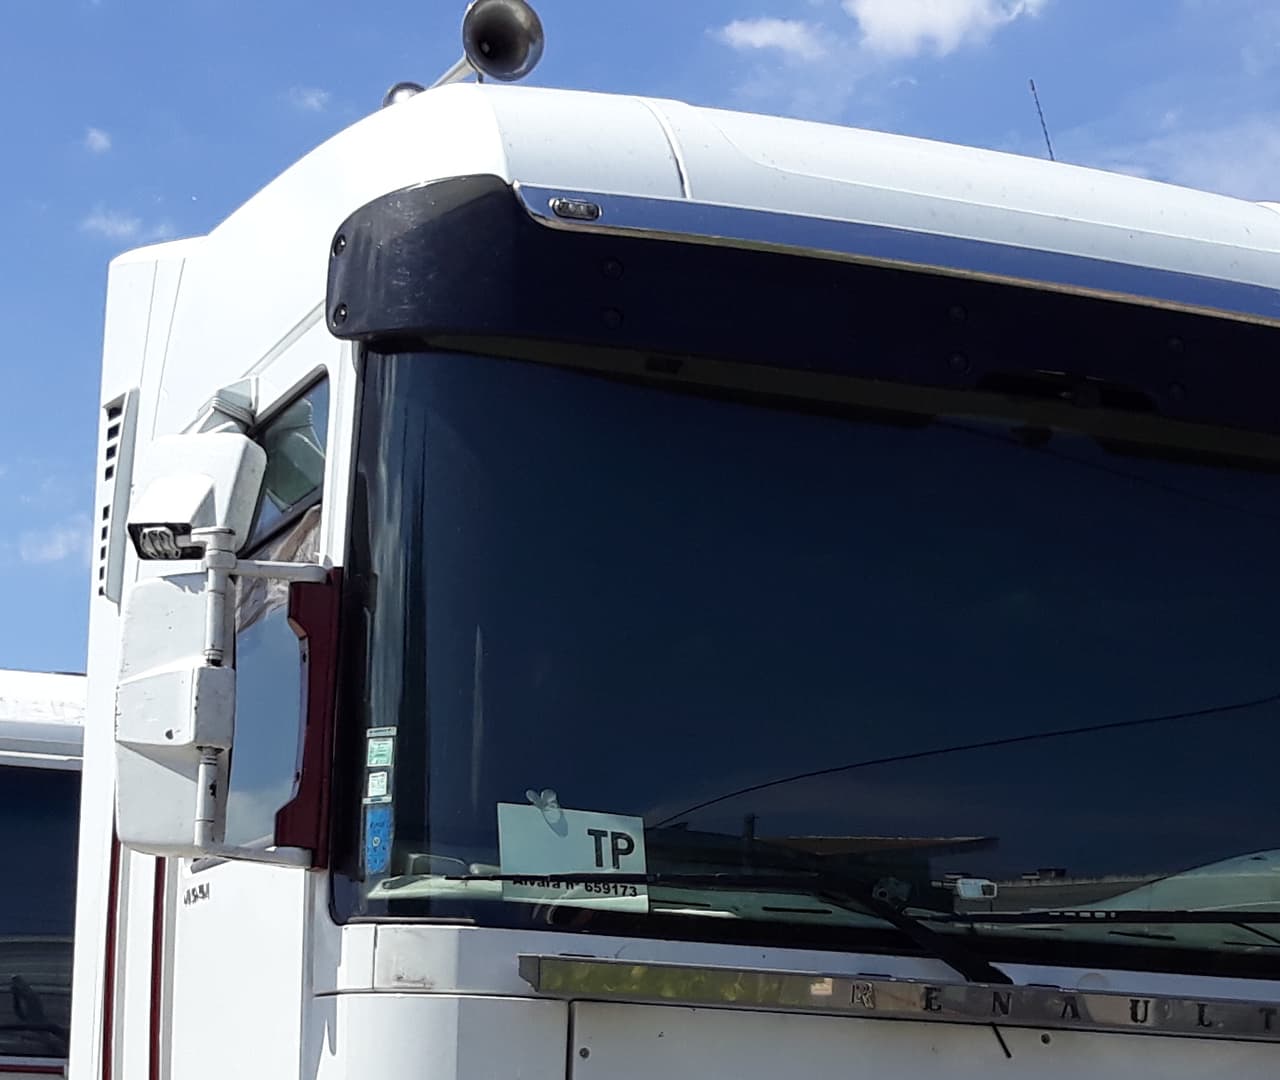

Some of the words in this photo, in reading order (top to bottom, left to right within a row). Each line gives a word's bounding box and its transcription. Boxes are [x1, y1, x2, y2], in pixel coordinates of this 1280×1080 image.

[587, 828, 635, 870] TP
[584, 882, 638, 898] 659173
[851, 982, 1277, 1032] RENAULT
